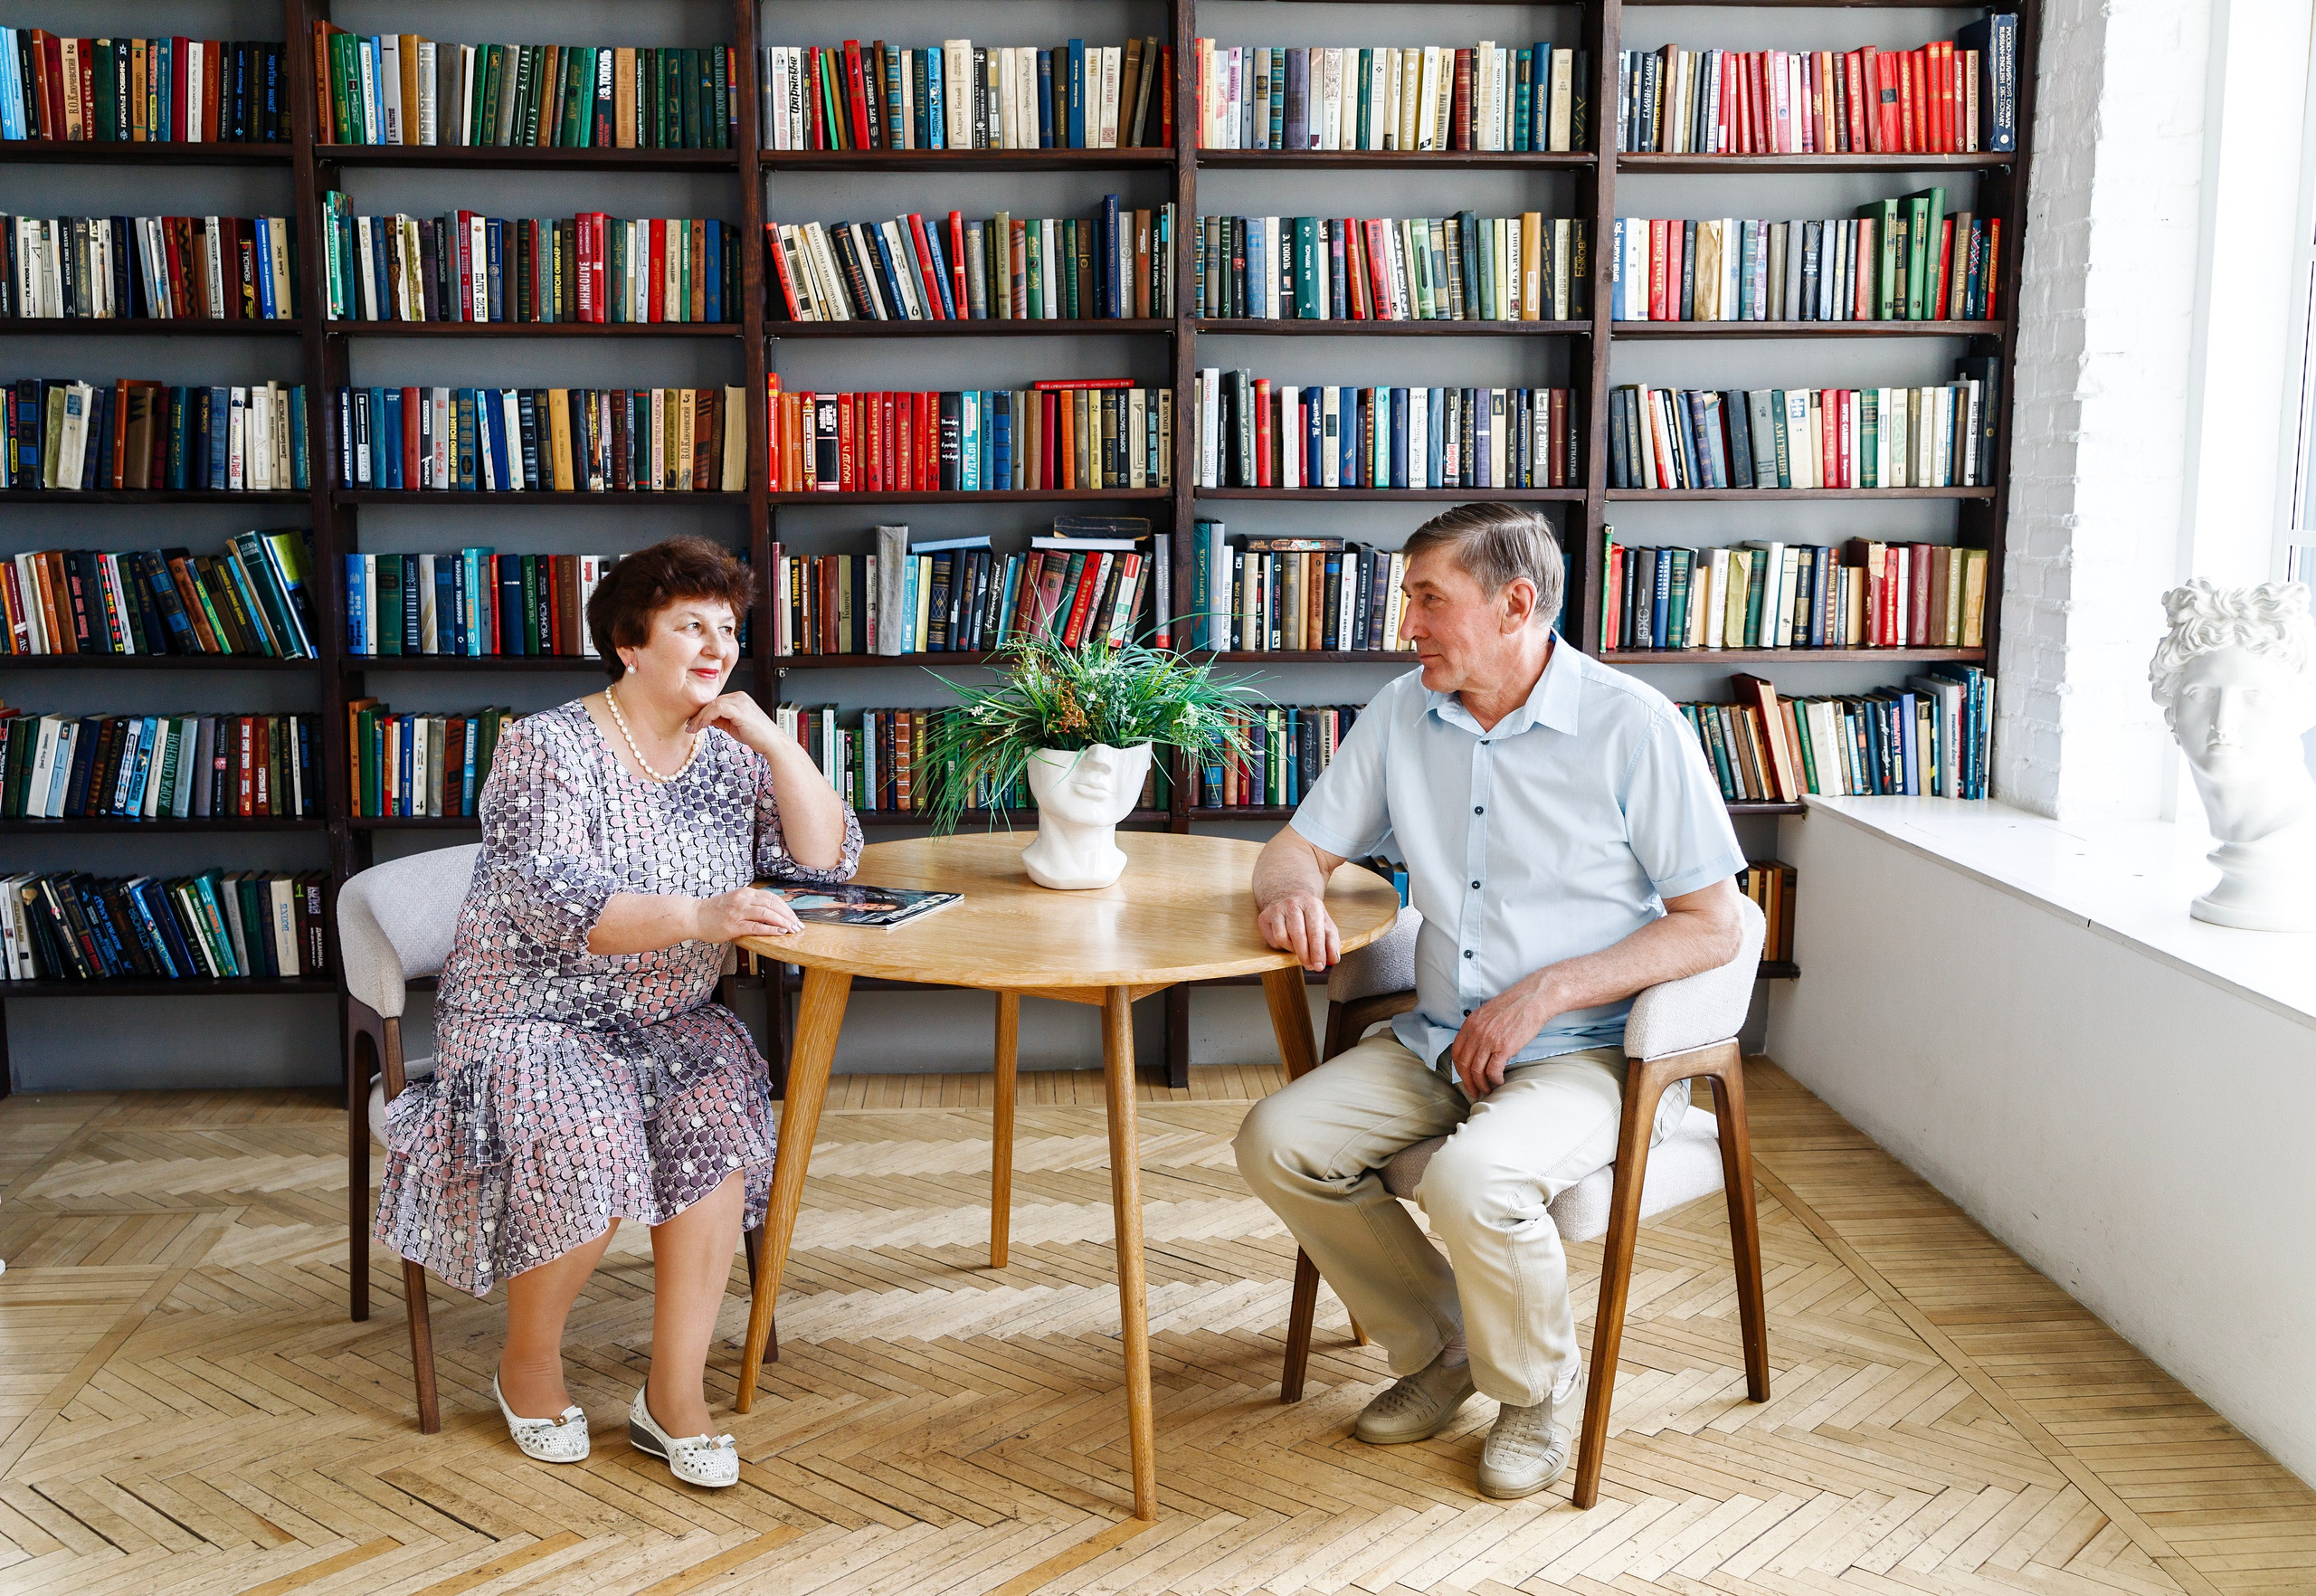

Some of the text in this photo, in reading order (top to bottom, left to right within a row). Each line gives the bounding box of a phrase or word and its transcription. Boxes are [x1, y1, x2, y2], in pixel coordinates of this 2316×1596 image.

[66, 58, 80, 114] В.О.Ключевский
[599, 50, 612, 96] Э.ТОПОЛЬ
[715, 46, 726, 128] МОСКОВСКИЙ КЛУБ
[866, 75, 877, 124] КУРТ ВОННЕГУТ
[1535, 112, 1543, 143] ВЛАДИМИР
[327, 221, 336, 278] ПРИРОДОВЕДЕНИЕ
[437, 223, 445, 260] ПАСТЕРНАК
[809, 225, 825, 263] РЕЦЕПТУРОЙ
[1282, 242, 1291, 270] ТОПОЛЬ
[475, 273, 484, 294] МАРШ
[579, 261, 590, 310] ЗАЛОЖНИК
[823, 270, 840, 317] ФАРМАКОЛОГИЯ
[1955, 272, 1967, 290] СПОК
[1204, 378, 1212, 402] DevOps
[680, 406, 691, 460] В.О.Ключевский
[818, 408, 826, 429] ВОЙНА
[870, 398, 879, 434] Кристи
[929, 397, 937, 433] Кристи
[1241, 428, 1249, 456] Сологуб
[1447, 444, 1457, 474] МАФИЯ
[1535, 434, 1547, 465] Банда
[231, 455, 241, 477] ВРАГИ
[899, 451, 908, 488] Кристи
[967, 442, 976, 486] ФАРДЖОН
[1201, 450, 1210, 477] Проект
[792, 567, 800, 606] Э.ТОПОЛЬ
[841, 589, 850, 619] Ковчег
[466, 598, 474, 630] ФИЗИКА
[539, 602, 547, 639] УСТИНОВА
[868, 617, 876, 647] март
[465, 723, 475, 765] ДАШКОВА
[866, 726, 874, 757] ГАЙДАР
[159, 732, 180, 807] ЖОРЖ СИМЕНОН
[128, 907, 154, 951] УСТИНОВА
[205, 904, 223, 934] ФИЗИКА
[152, 929, 169, 959] СЕРОВА
